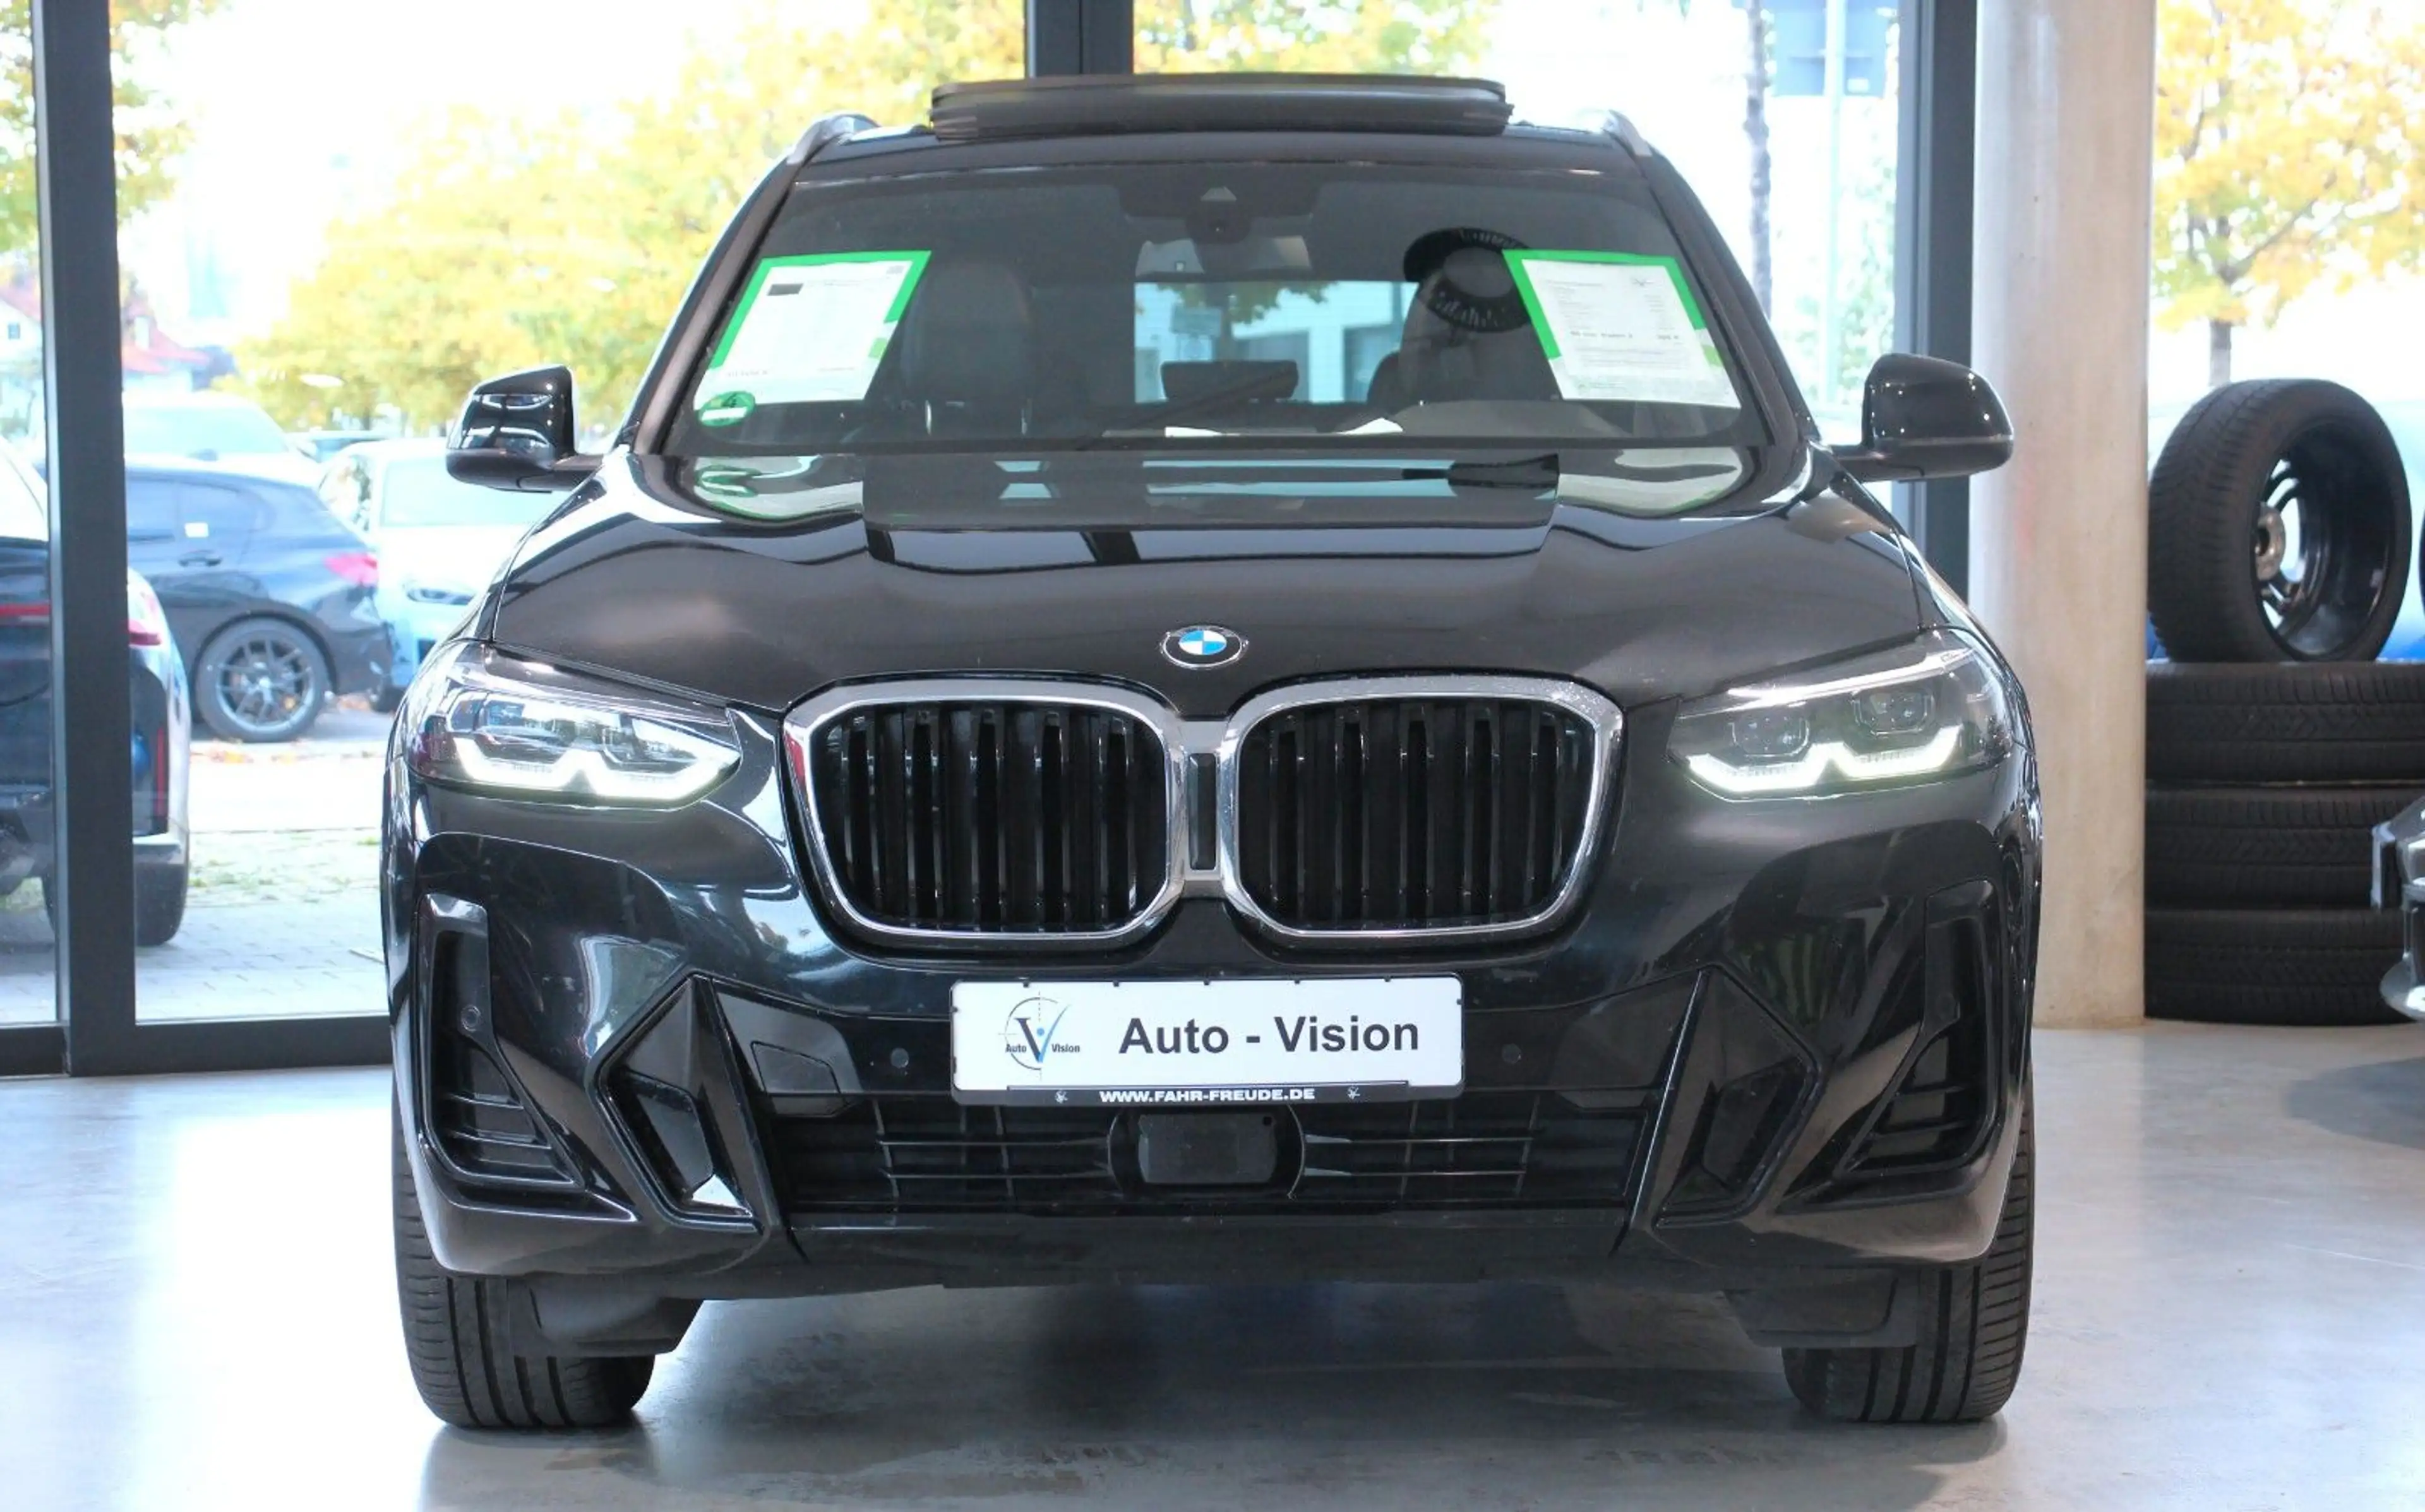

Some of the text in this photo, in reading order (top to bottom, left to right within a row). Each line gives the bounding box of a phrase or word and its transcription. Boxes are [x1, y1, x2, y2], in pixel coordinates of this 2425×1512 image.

[1118, 1016, 1229, 1054] Auto
[1274, 1015, 1418, 1053] Vision
[1005, 1043, 1081, 1053] Auto Vision
[1099, 1088, 1315, 1104] WWW.FAHR-FREUDE.DE
